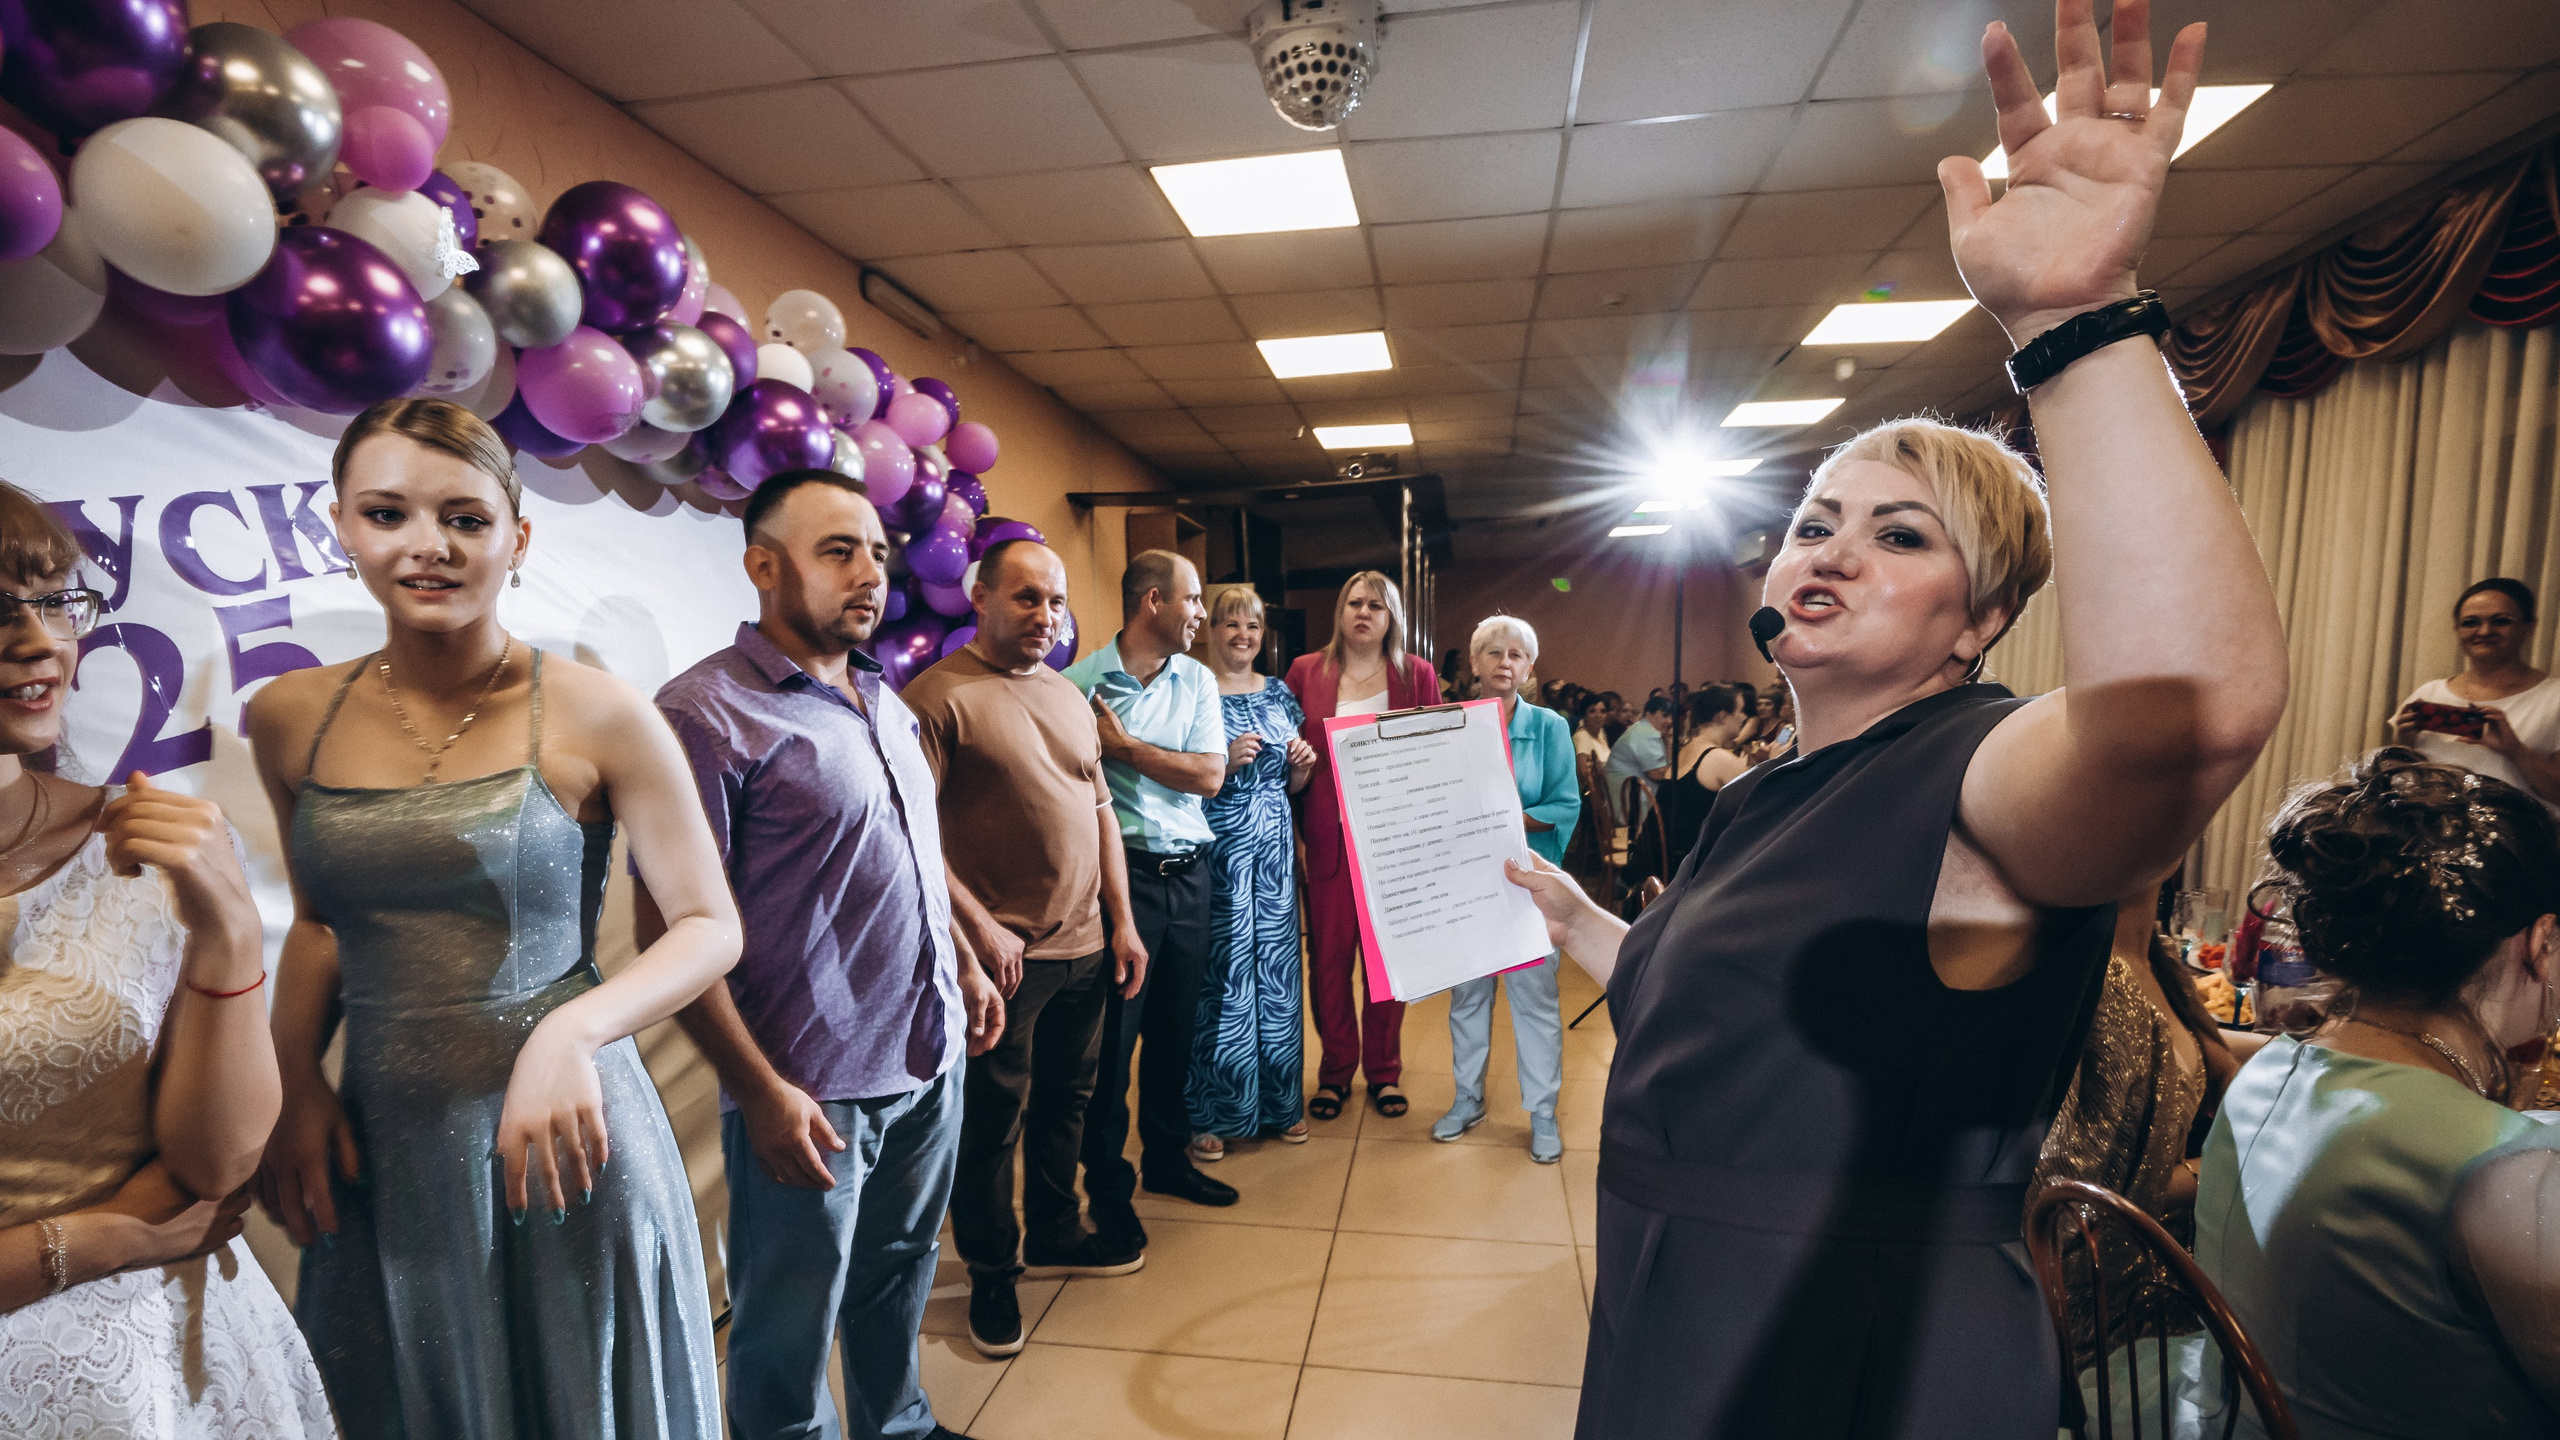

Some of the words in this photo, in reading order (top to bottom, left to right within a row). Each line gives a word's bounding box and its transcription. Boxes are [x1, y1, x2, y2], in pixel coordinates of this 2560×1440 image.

[70, 594, 324, 786] 25
[1349, 738, 1379, 749] КОНКУРС
[1352, 755, 1362, 763] Две
[1360, 795, 1381, 804] Только
[1406, 786, 1425, 796] рюмка
[1424, 782, 1441, 791] водки
[1448, 778, 1464, 786] столе
[1366, 821, 1386, 831] Новый
[1429, 809, 1449, 818] мчится
[1369, 836, 1391, 845] Потому
[1462, 813, 1491, 824] статистике
[1495, 808, 1510, 818] ребят
[1372, 849, 1396, 859] Сегодня
[1395, 843, 1421, 854] праздник
[1475, 826, 1491, 835] будут
[1491, 823, 1508, 831] танцы
[1376, 863, 1397, 872] Любовь
[1441, 849, 1451, 857] сон
[1377, 879, 1386, 887] Не
[1381, 886, 1418, 900] Единственная
[1387, 915, 1409, 927] Забирай
[1409, 913, 1423, 921] меня
[1473, 895, 1483, 903] 100
[1483, 890, 1499, 900] морей
[1446, 917, 1459, 925] жара
